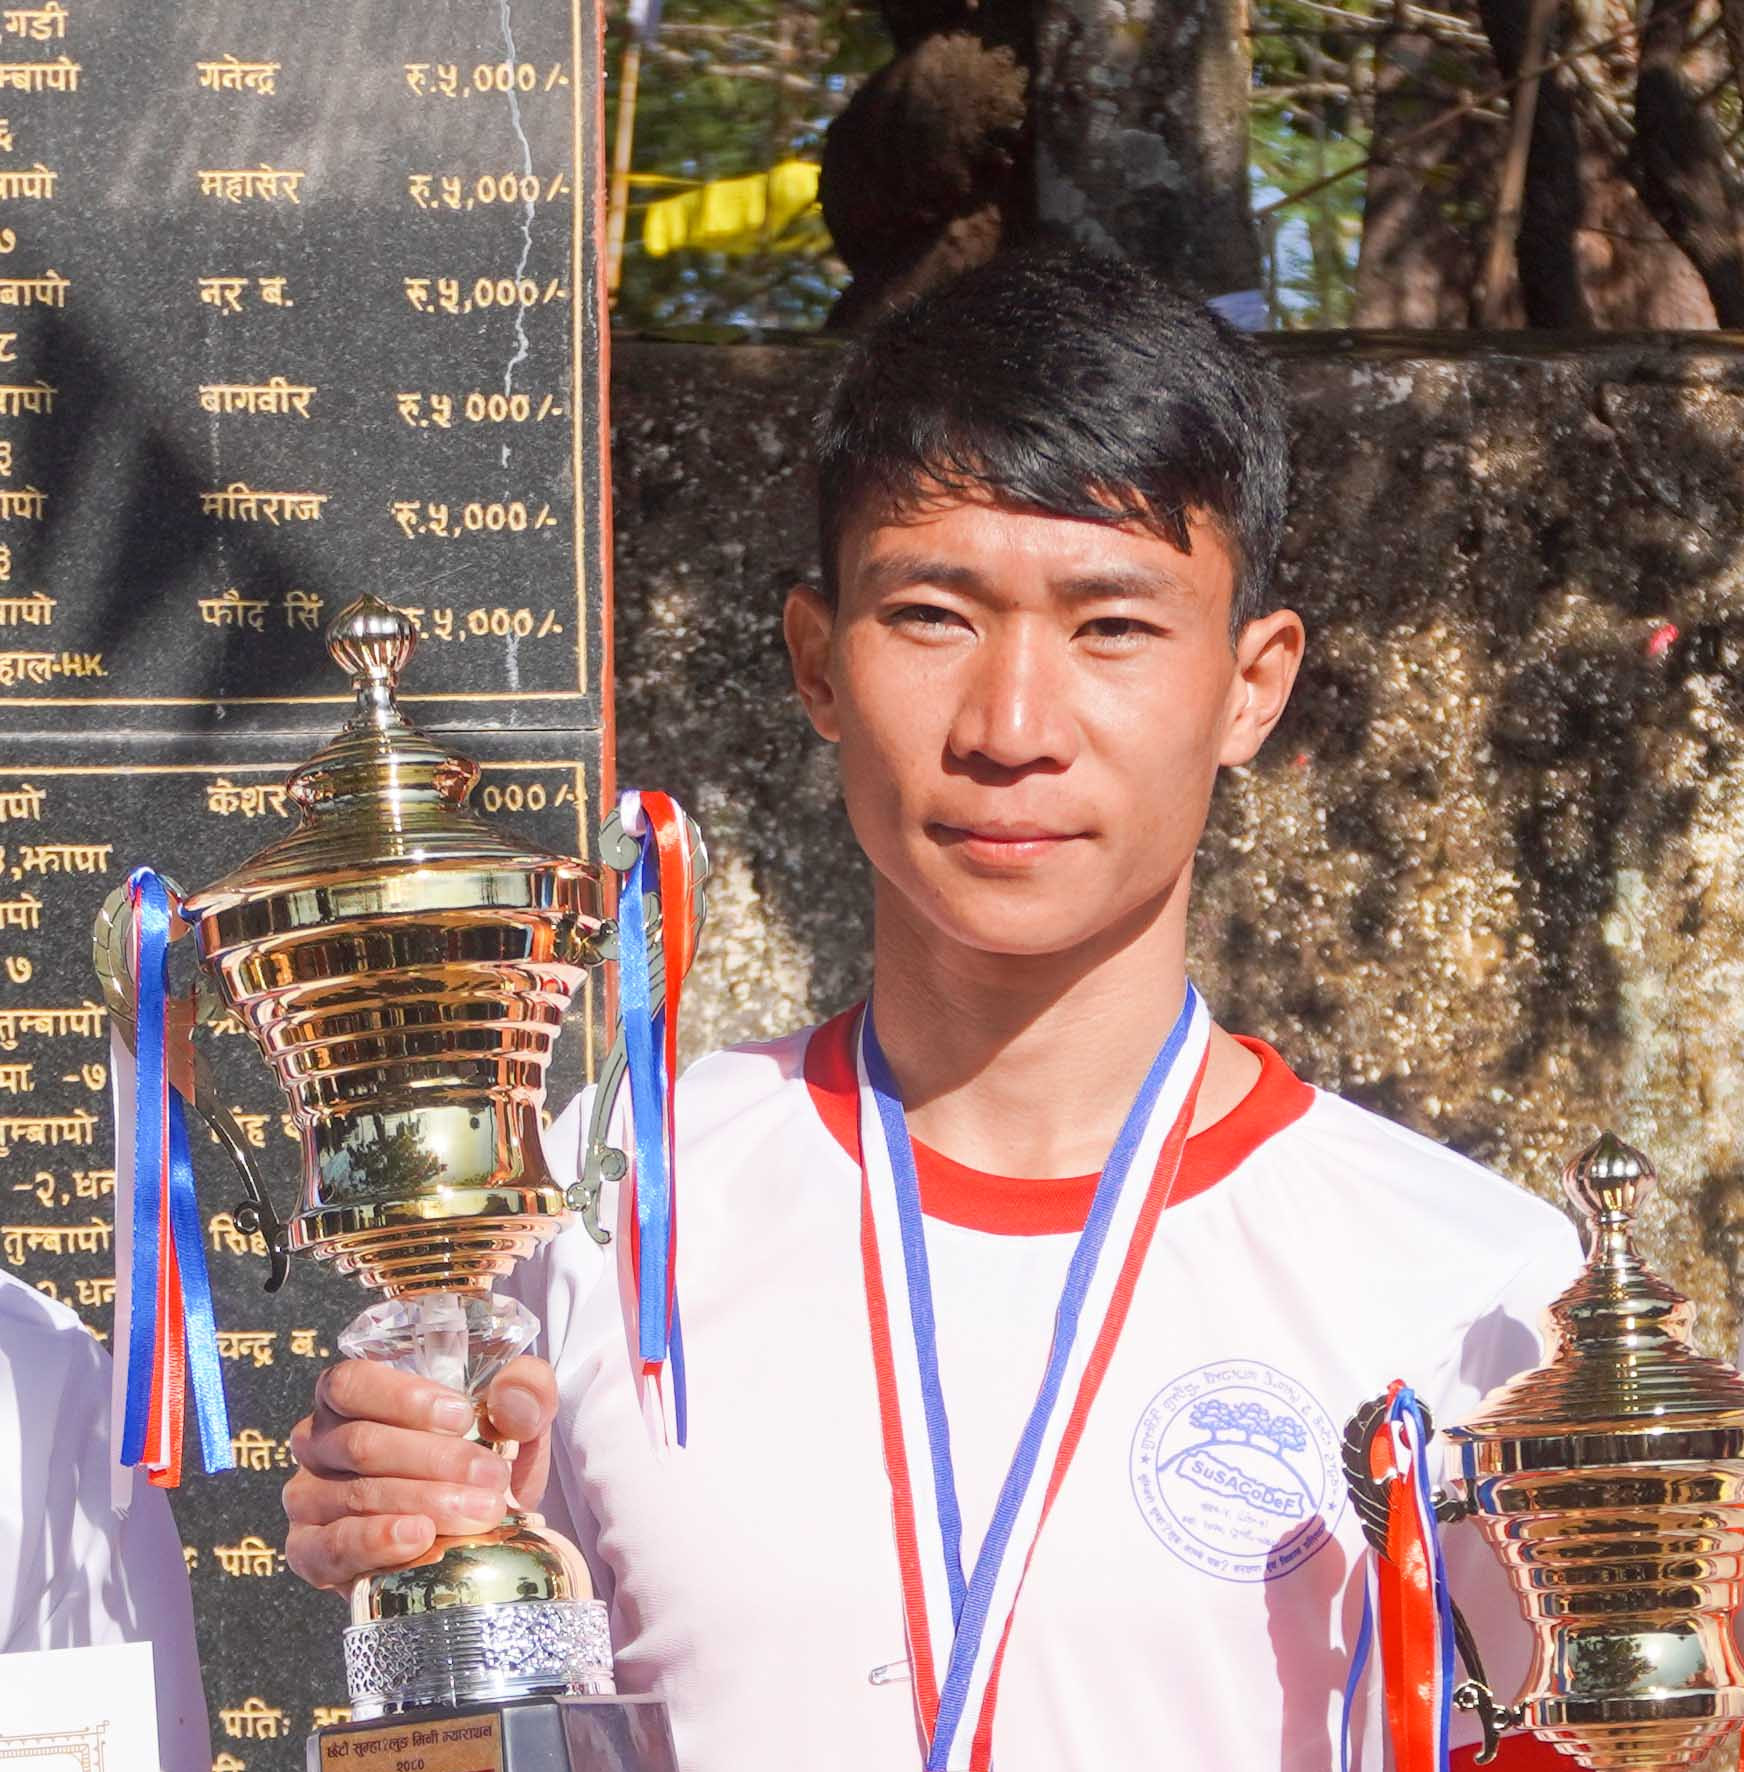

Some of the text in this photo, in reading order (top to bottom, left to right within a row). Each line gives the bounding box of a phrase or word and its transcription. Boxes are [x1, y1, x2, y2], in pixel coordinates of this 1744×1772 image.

[197, 163, 305, 203] महासेर
[200, 481, 328, 526] मतिराज
[1, 1217, 114, 1265] तुम्बापो
